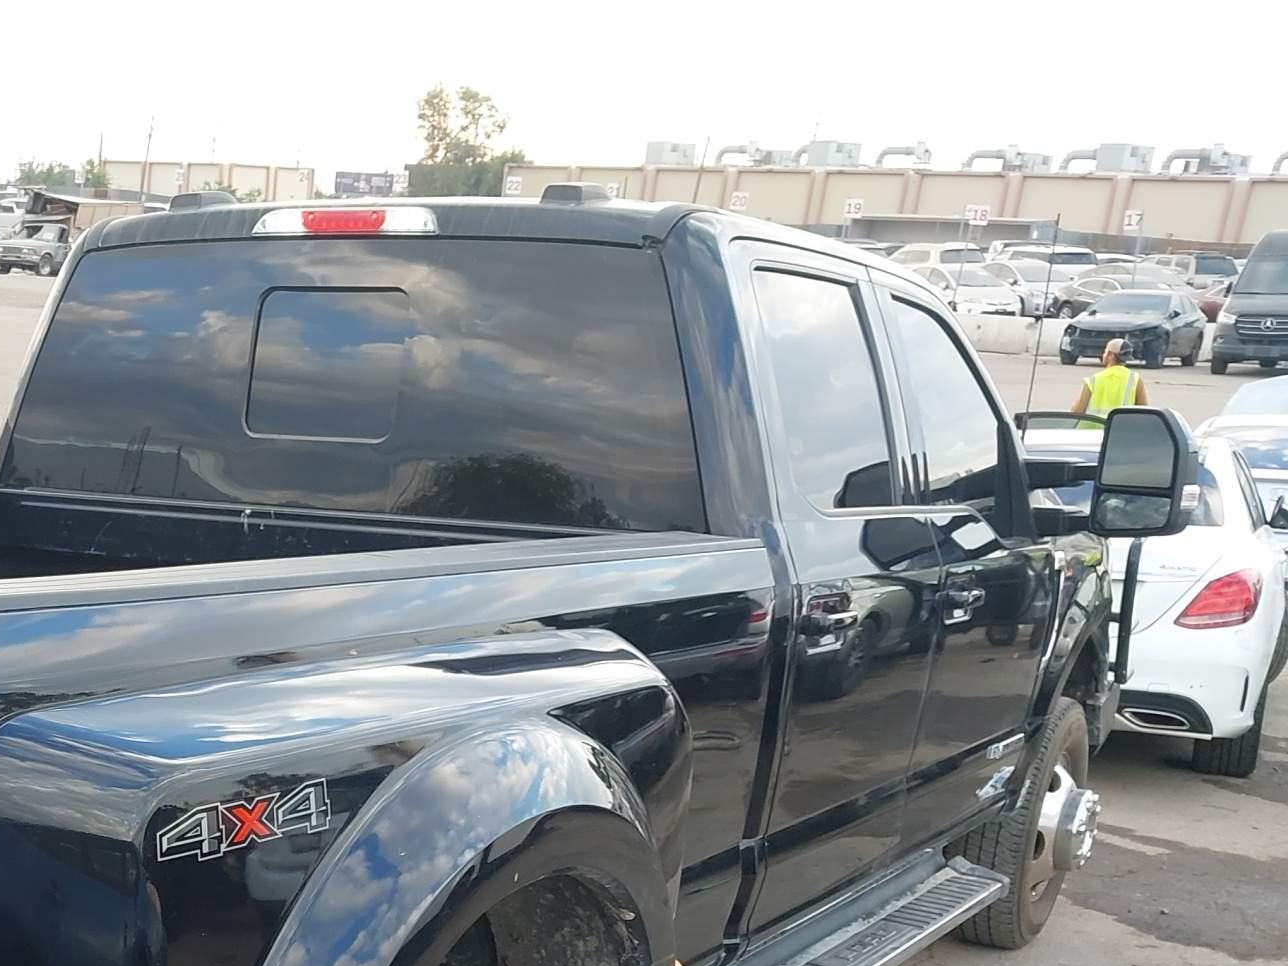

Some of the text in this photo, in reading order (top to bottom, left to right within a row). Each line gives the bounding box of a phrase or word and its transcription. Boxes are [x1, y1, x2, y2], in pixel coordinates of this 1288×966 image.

[845, 202, 862, 215] 19
[972, 209, 989, 222] 18
[1125, 213, 1144, 226] 17
